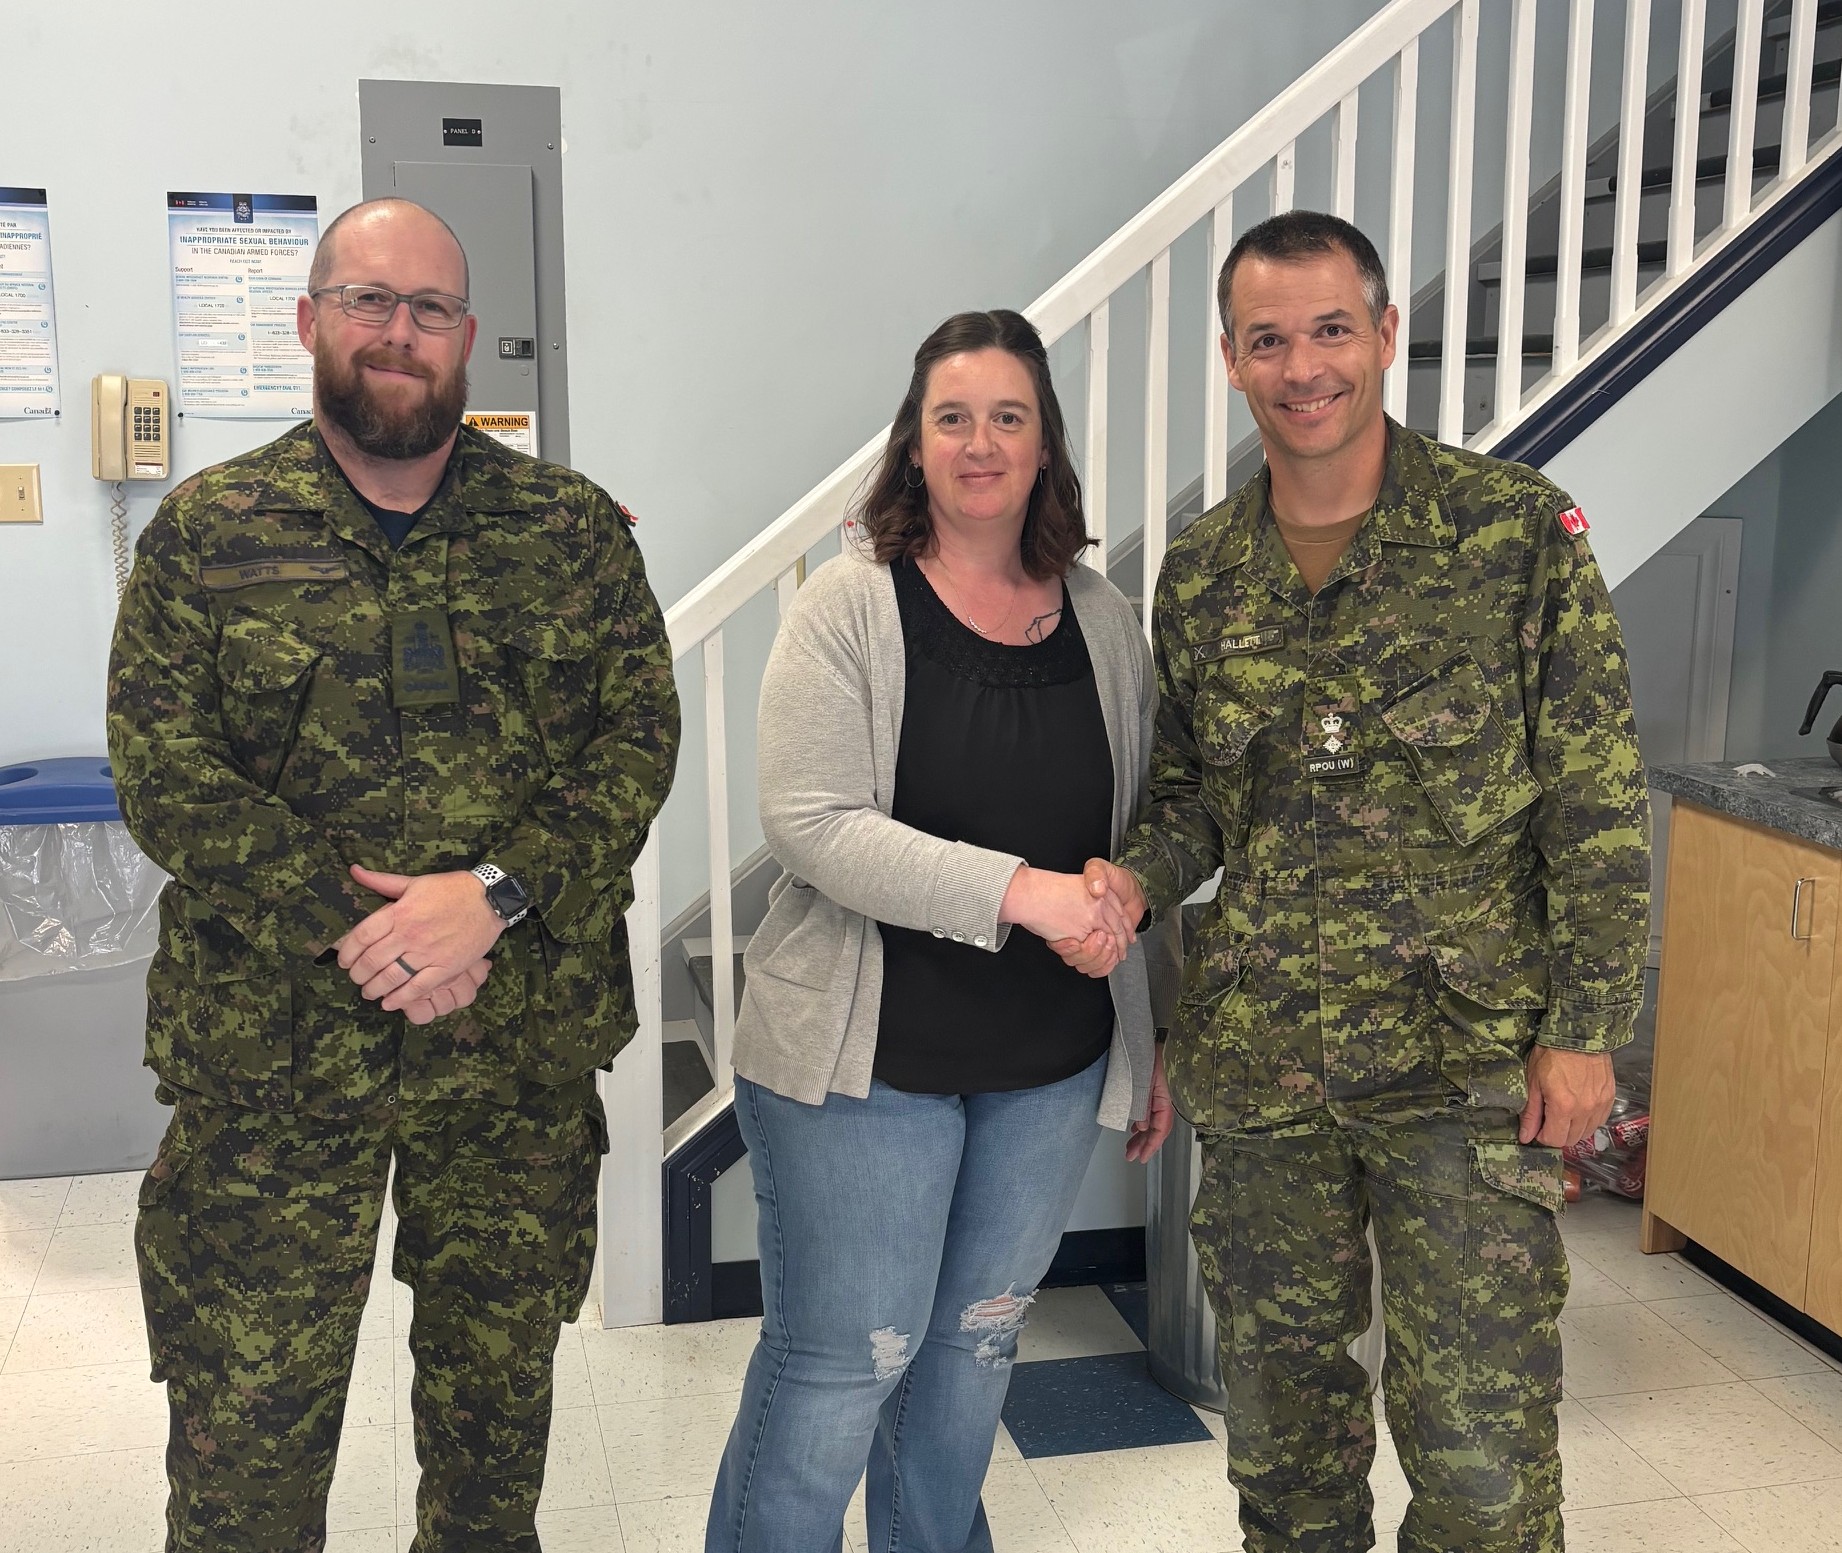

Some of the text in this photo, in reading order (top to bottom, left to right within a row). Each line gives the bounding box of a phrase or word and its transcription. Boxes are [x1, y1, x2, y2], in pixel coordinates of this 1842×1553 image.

[180, 236, 309, 247] INAPPROPRIATE SEXUAL BEHAVIOUR
[200, 247, 211, 255] THE
[213, 248, 246, 256] CANADIAN
[270, 249, 299, 257] FORCES?
[291, 406, 314, 415] Canad
[480, 417, 529, 427] WARNING
[238, 566, 280, 580] WATTS
[1309, 757, 1355, 773] RPOU (W)
